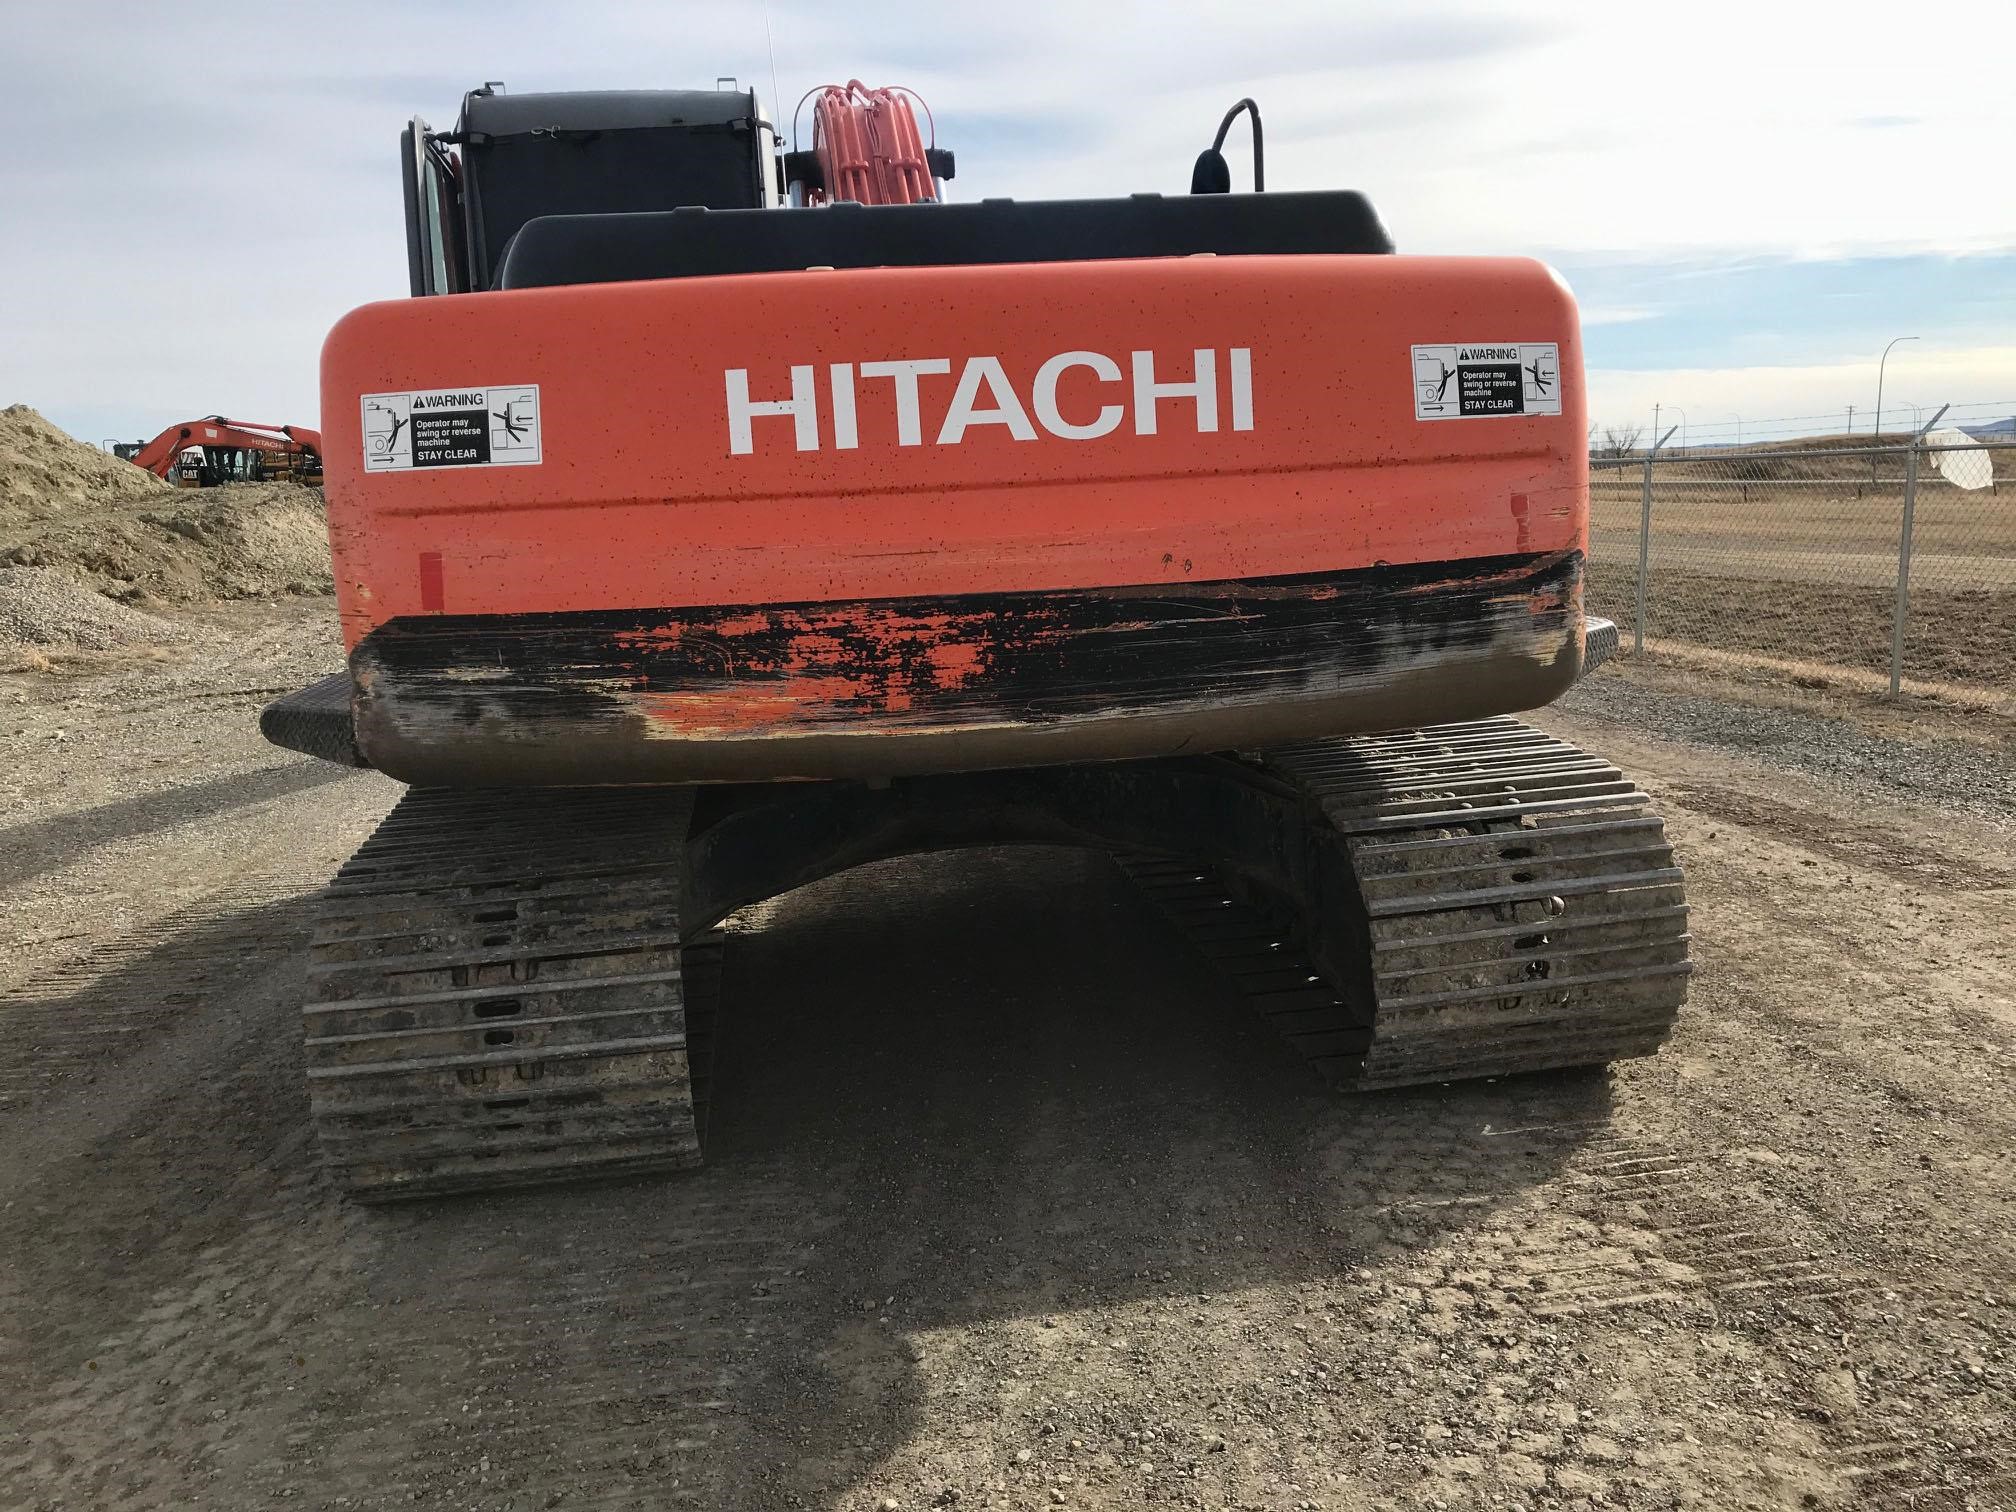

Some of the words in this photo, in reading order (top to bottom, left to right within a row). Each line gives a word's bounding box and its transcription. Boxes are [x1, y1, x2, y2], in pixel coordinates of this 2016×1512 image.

[1470, 348, 1517, 360] WARNING
[1462, 371, 1492, 381] Operator
[1492, 372, 1507, 380] may
[1463, 380, 1483, 389] swing
[425, 393, 484, 408] WARNING
[724, 346, 1254, 455] HITACHI
[1464, 400, 1485, 409] STAY
[1487, 400, 1514, 409] CLEAR
[416, 420, 450, 430] Operator
[452, 419, 469, 427] may
[416, 430, 440, 438] swing
[451, 428, 481, 436] reverse
[251, 438, 284, 449] HITACHI
[417, 438, 450, 447] machine
[417, 450, 442, 460] STAY
[444, 449, 477, 459] CLEAR
[182, 469, 198, 479] CAT
